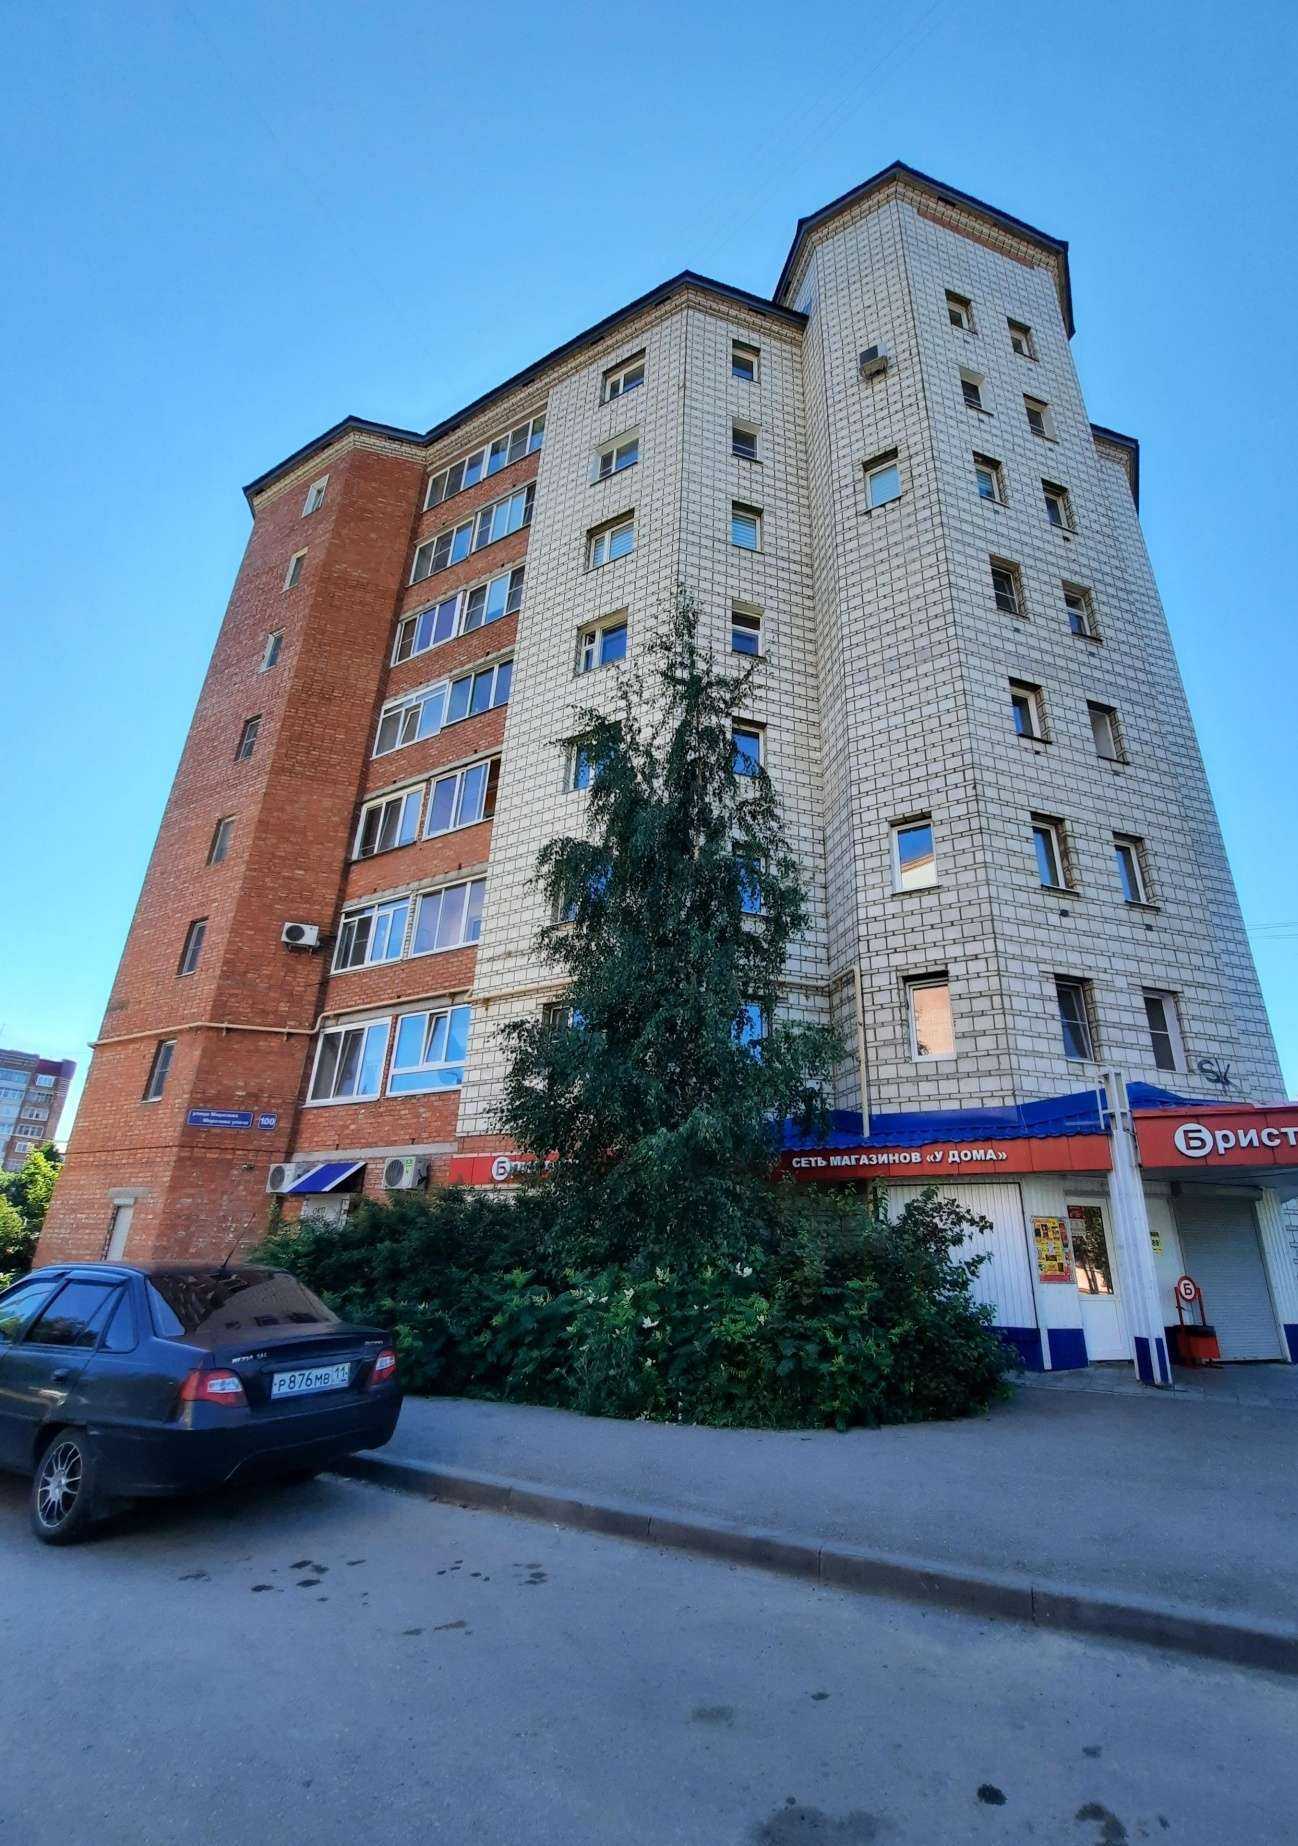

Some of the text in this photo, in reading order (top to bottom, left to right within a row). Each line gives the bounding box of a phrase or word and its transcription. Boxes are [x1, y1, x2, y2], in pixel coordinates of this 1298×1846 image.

[260, 1116, 276, 1126] 100
[792, 1149, 1008, 1168] СЕТЬ МАГАЗИНОВ «У ДОМА»
